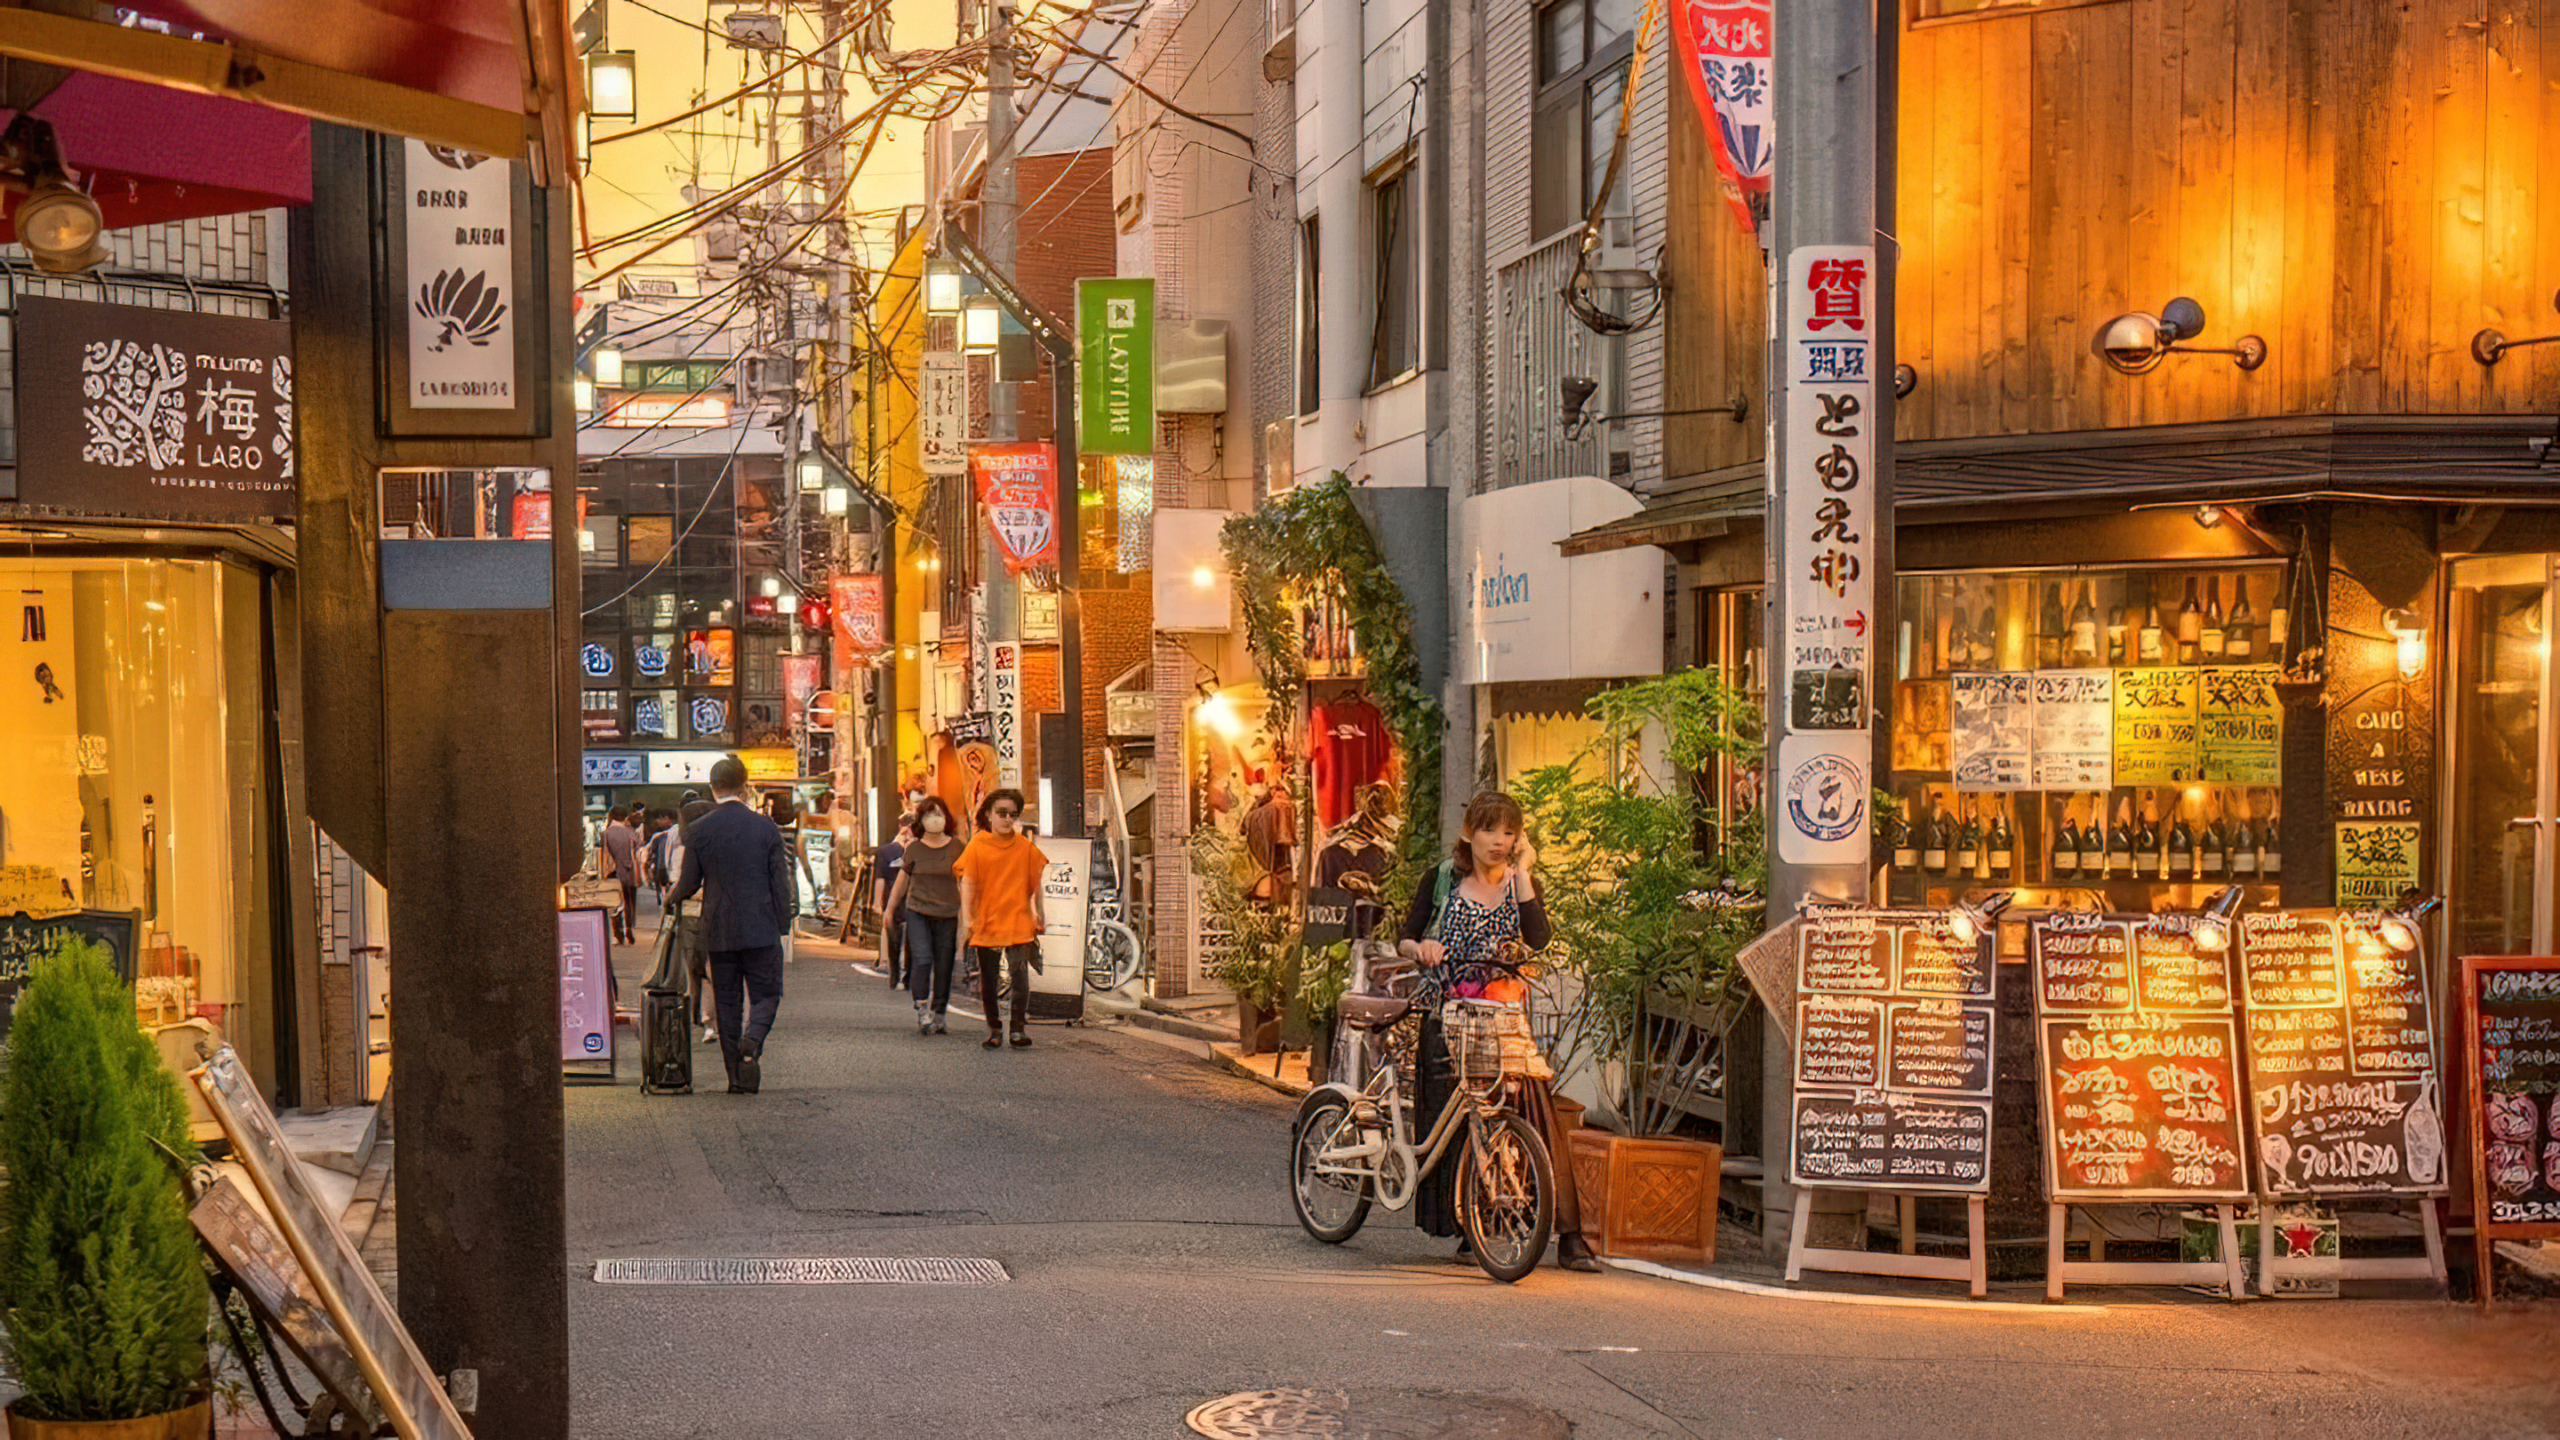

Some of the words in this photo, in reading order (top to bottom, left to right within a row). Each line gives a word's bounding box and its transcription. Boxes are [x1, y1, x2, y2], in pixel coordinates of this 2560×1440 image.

[1806, 258, 1867, 331] 質
[196, 376, 259, 440] 梅
[197, 443, 263, 470] LABO
